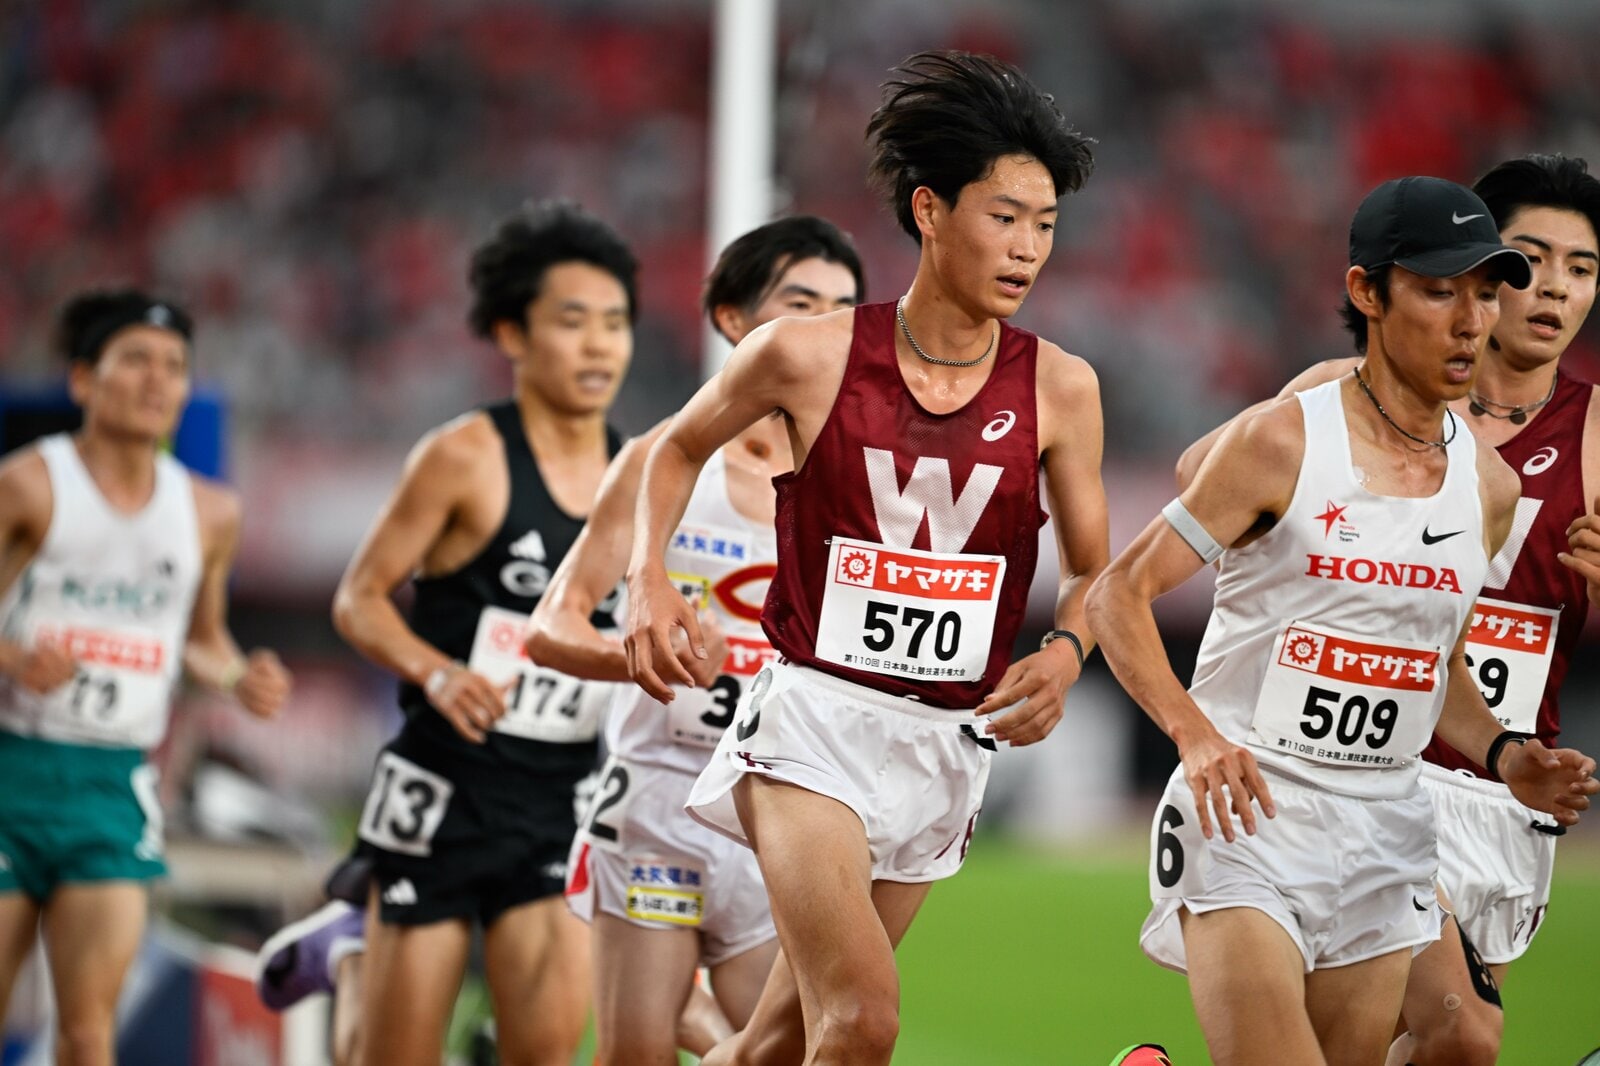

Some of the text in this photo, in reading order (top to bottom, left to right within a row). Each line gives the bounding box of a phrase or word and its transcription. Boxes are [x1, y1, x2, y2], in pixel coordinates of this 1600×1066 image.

[863, 446, 1005, 554] W
[882, 560, 990, 593] ヤマザキ
[1305, 554, 1463, 594] HONDA
[844, 653, 881, 668] 第110回
[862, 600, 962, 662] 570
[1330, 646, 1432, 683] ヤマザキ
[1464, 652, 1509, 708] 9
[1277, 737, 1315, 755] 第110回
[1300, 685, 1399, 749] 509
[371, 766, 436, 842] 13
[588, 765, 630, 843] 2
[1156, 804, 1184, 888] 6
